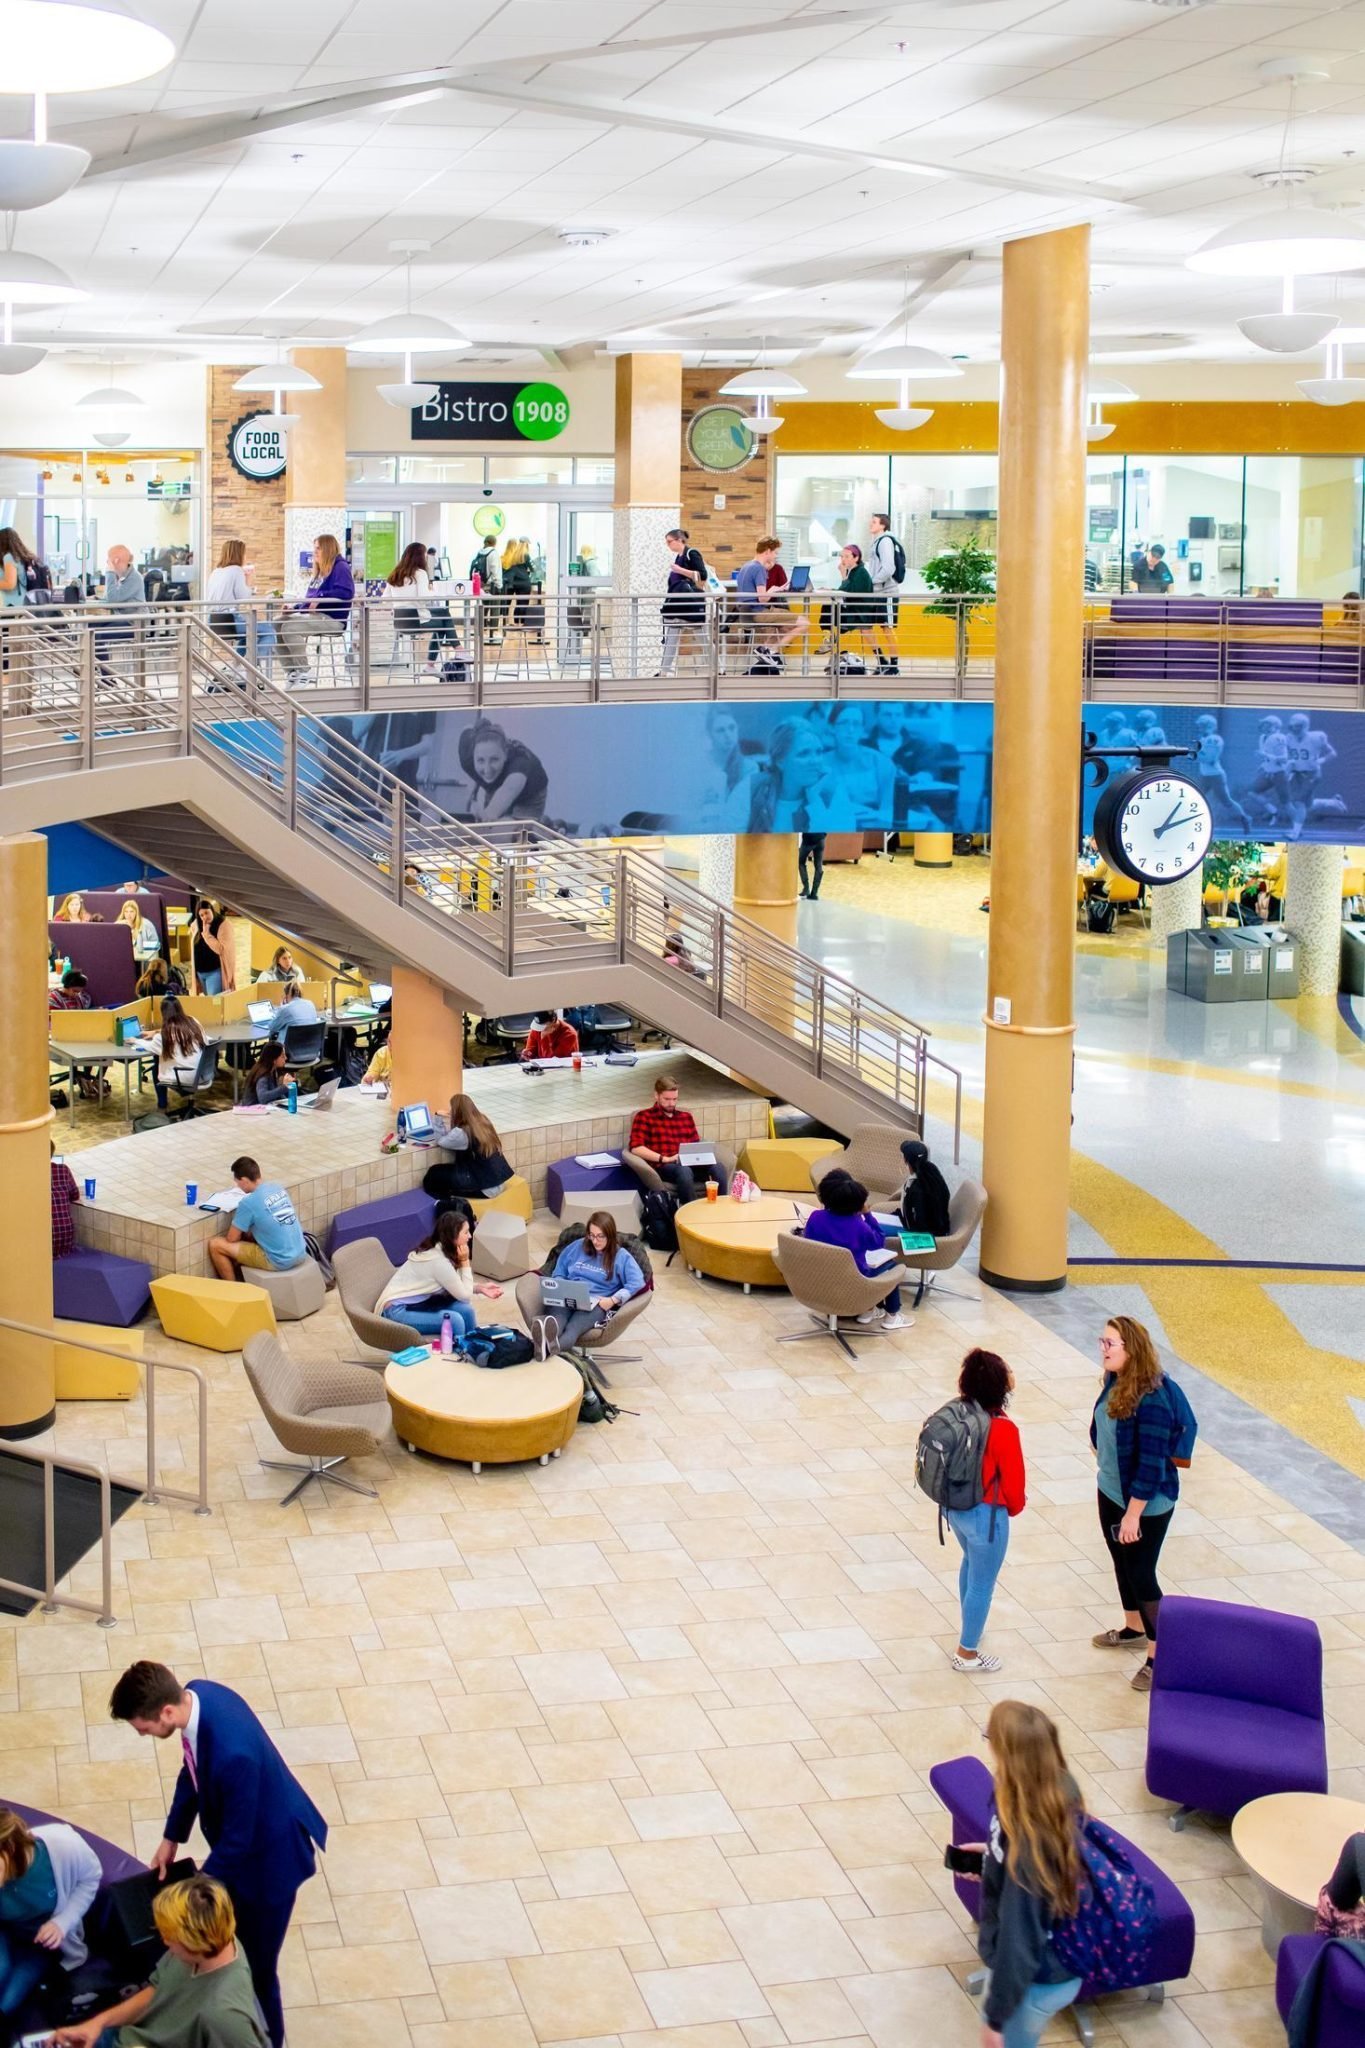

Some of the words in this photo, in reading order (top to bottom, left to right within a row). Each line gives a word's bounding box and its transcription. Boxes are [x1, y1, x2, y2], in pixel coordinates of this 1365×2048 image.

[421, 391, 508, 422] Bistro
[516, 401, 567, 423] 1908
[702, 416, 725, 427] GET
[245, 432, 280, 445] FOOD
[698, 428, 730, 440] YOUR
[695, 440, 734, 451] GREEN
[242, 446, 285, 459] LOCAL
[704, 452, 724, 463] ON
[1155, 782, 1171, 793] 12
[1179, 788, 1185, 798] 1
[1138, 789, 1152, 800] 11
[1125, 805, 1140, 816] 10
[1189, 802, 1198, 813] 2
[1121, 823, 1128, 833] 9
[1194, 822, 1202, 833] 3
[1125, 842, 1133, 853] 8
[1187, 841, 1195, 852] 4
[1138, 858, 1147, 868] 7
[1155, 862, 1164, 873] 6
[1174, 857, 1183, 868] 5
